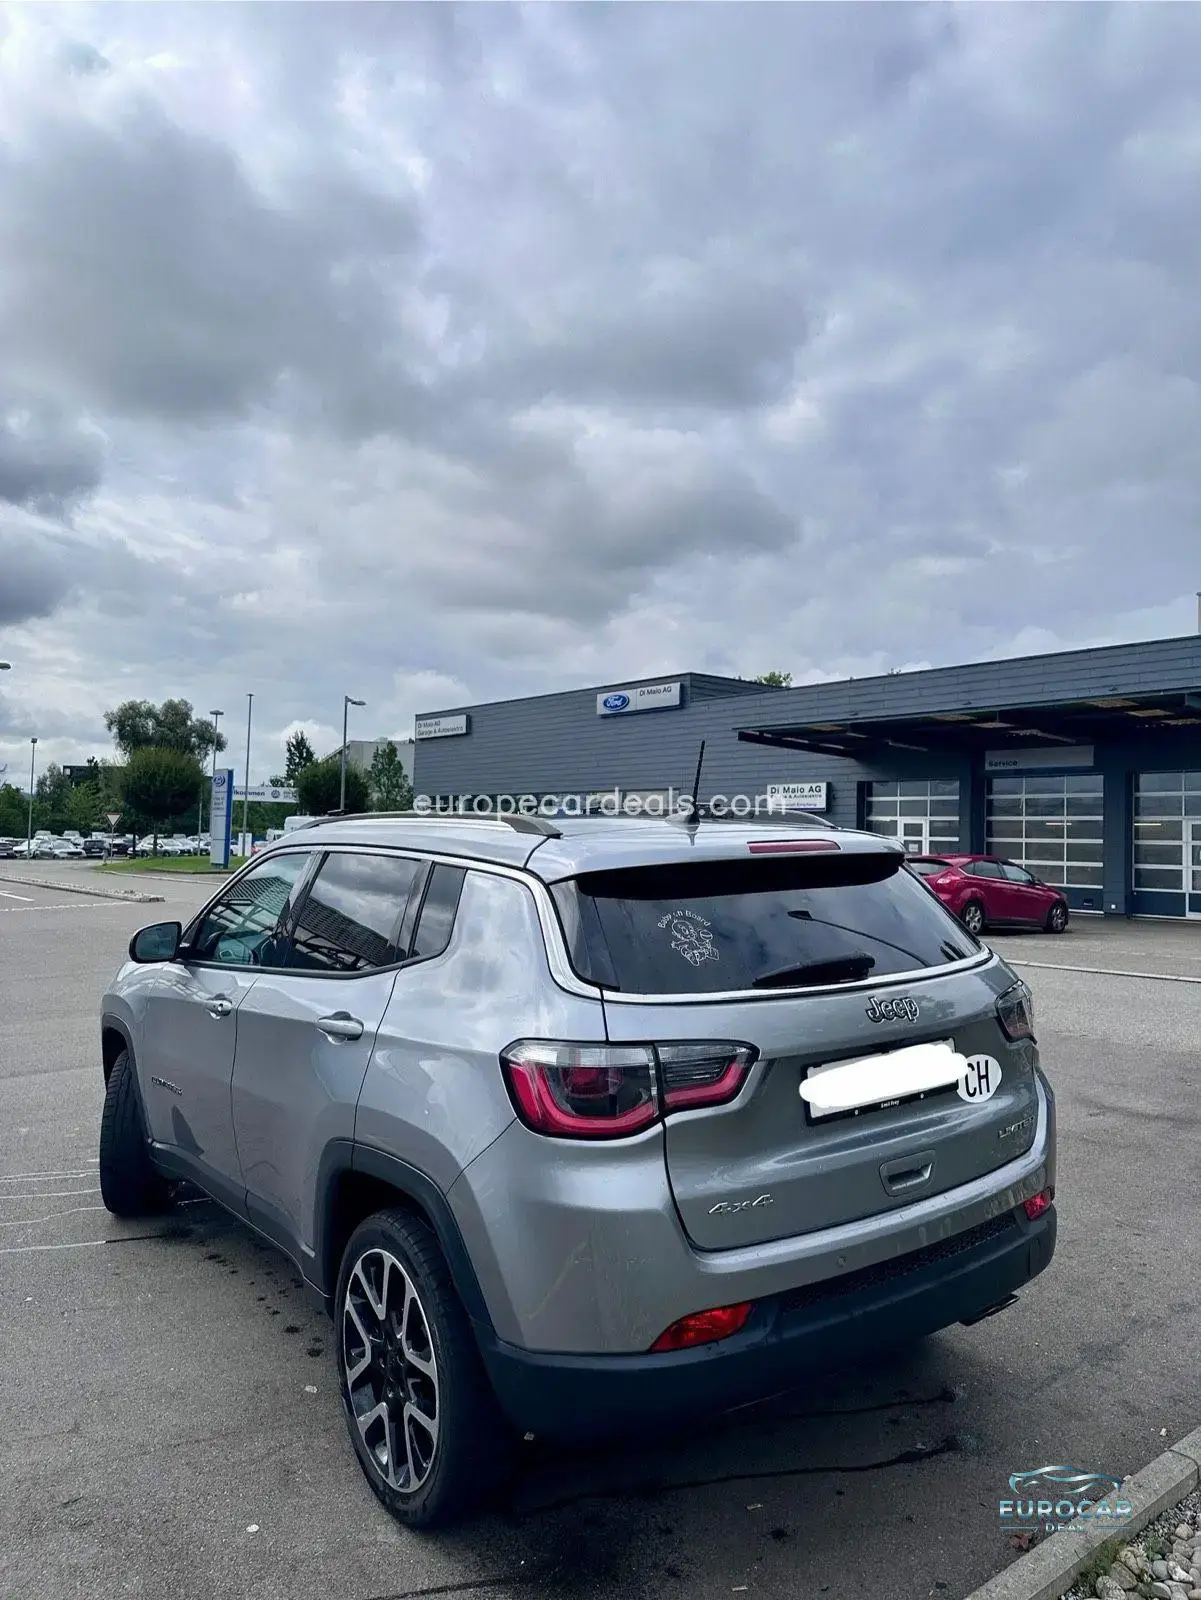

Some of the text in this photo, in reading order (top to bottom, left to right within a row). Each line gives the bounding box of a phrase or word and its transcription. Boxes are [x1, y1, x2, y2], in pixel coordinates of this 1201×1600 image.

[647, 687, 662, 695] Maio
[770, 785, 822, 794] Di Maio AG
[685, 909, 711, 927] Board
[865, 996, 920, 1023] Jeep
[965, 1059, 990, 1098] CH
